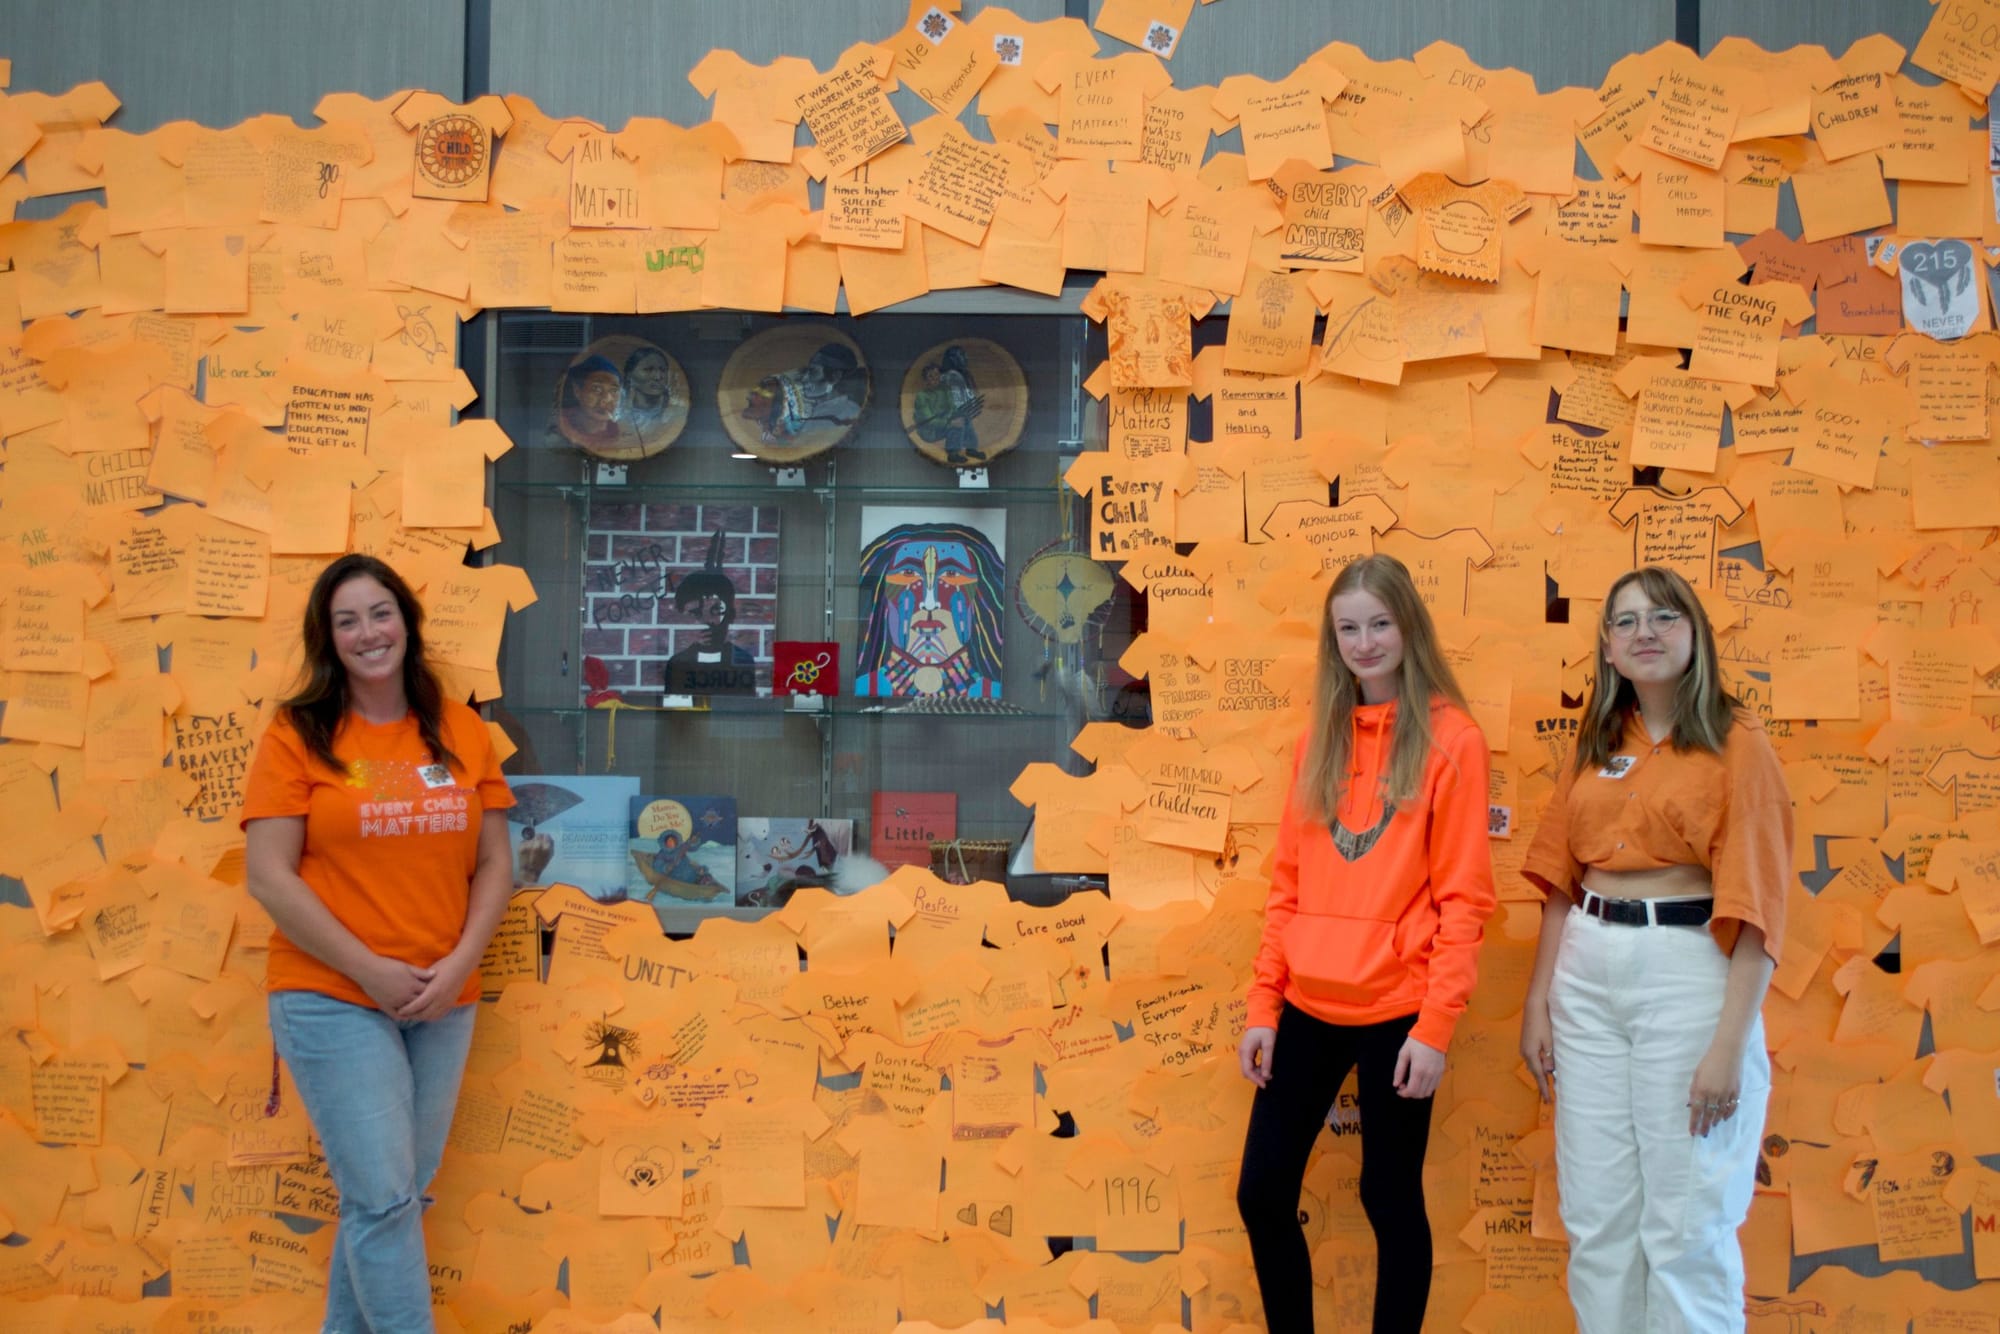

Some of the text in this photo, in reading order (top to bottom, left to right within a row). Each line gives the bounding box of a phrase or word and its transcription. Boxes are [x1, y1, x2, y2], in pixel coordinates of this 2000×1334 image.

[897, 41, 929, 72] We
[1075, 69, 1115, 90] EVERY
[794, 93, 807, 110] IT
[809, 83, 829, 100] WAS
[830, 70, 852, 87] THE
[803, 90, 845, 118] CHILDREN
[845, 80, 865, 96] HAD
[1837, 91, 1860, 102] The
[1077, 94, 1113, 106] CHILD
[849, 105, 868, 120] HAD
[1818, 104, 1879, 129] CHILDREN
[862, 122, 900, 150] CHILDREN
[825, 140, 850, 159] WHAT
[832, 184, 900, 200] times higher
[1293, 182, 1368, 209] EVERY
[1667, 189, 1698, 200] CHILD
[843, 206, 873, 217] RATE
[1304, 206, 1330, 222] child
[874, 215, 900, 229] youth
[1285, 224, 1365, 253] MATTERS
[1913, 249, 1958, 273] 215
[1712, 288, 1777, 315] CLOSING
[1706, 304, 1773, 328] THE GAP
[1922, 315, 1964, 329] NEVER
[323, 317, 347, 337] WE
[1842, 338, 1877, 360] We
[208, 355, 250, 379] We are
[293, 385, 375, 403] EDUCATION HAS
[1132, 392, 1174, 415] Child
[1221, 388, 1286, 400] Remembrance
[291, 400, 330, 411] GOTTEN
[334, 403, 347, 413] US
[1237, 407, 1257, 417] and
[290, 411, 368, 427] THIS MESS, AND
[1109, 406, 1171, 430] Matters
[288, 424, 349, 437] EDUCATION
[1225, 422, 1271, 439] Healing
[288, 435, 358, 449] WILL GET US
[1101, 475, 1163, 502] Every
[1101, 499, 1149, 525] Child
[1298, 512, 1363, 528] ACKNOWLEDGE
[1305, 527, 1360, 546] HONOUR
[598, 544, 671, 591] NEVER
[1153, 582, 1214, 602] Genocide
[173, 712, 237, 733] LOVE
[176, 727, 245, 750] RESPECT
[1160, 763, 1222, 786] REMEMBER
[1176, 783, 1199, 796] THE
[360, 798, 467, 818] EVERY CHILD
[361, 811, 468, 838] MATTERS
[884, 825, 936, 842] Little
[914, 886, 961, 914] Respect
[1016, 914, 1086, 937] Care about
[1055, 933, 1076, 945] and
[823, 995, 870, 1010] Better
[836, 1013, 859, 1022] the
[872, 1070, 896, 1081] what
[282, 1177, 306, 1192] can
[280, 1192, 301, 1210] the
[1104, 1177, 1161, 1217] 1996
